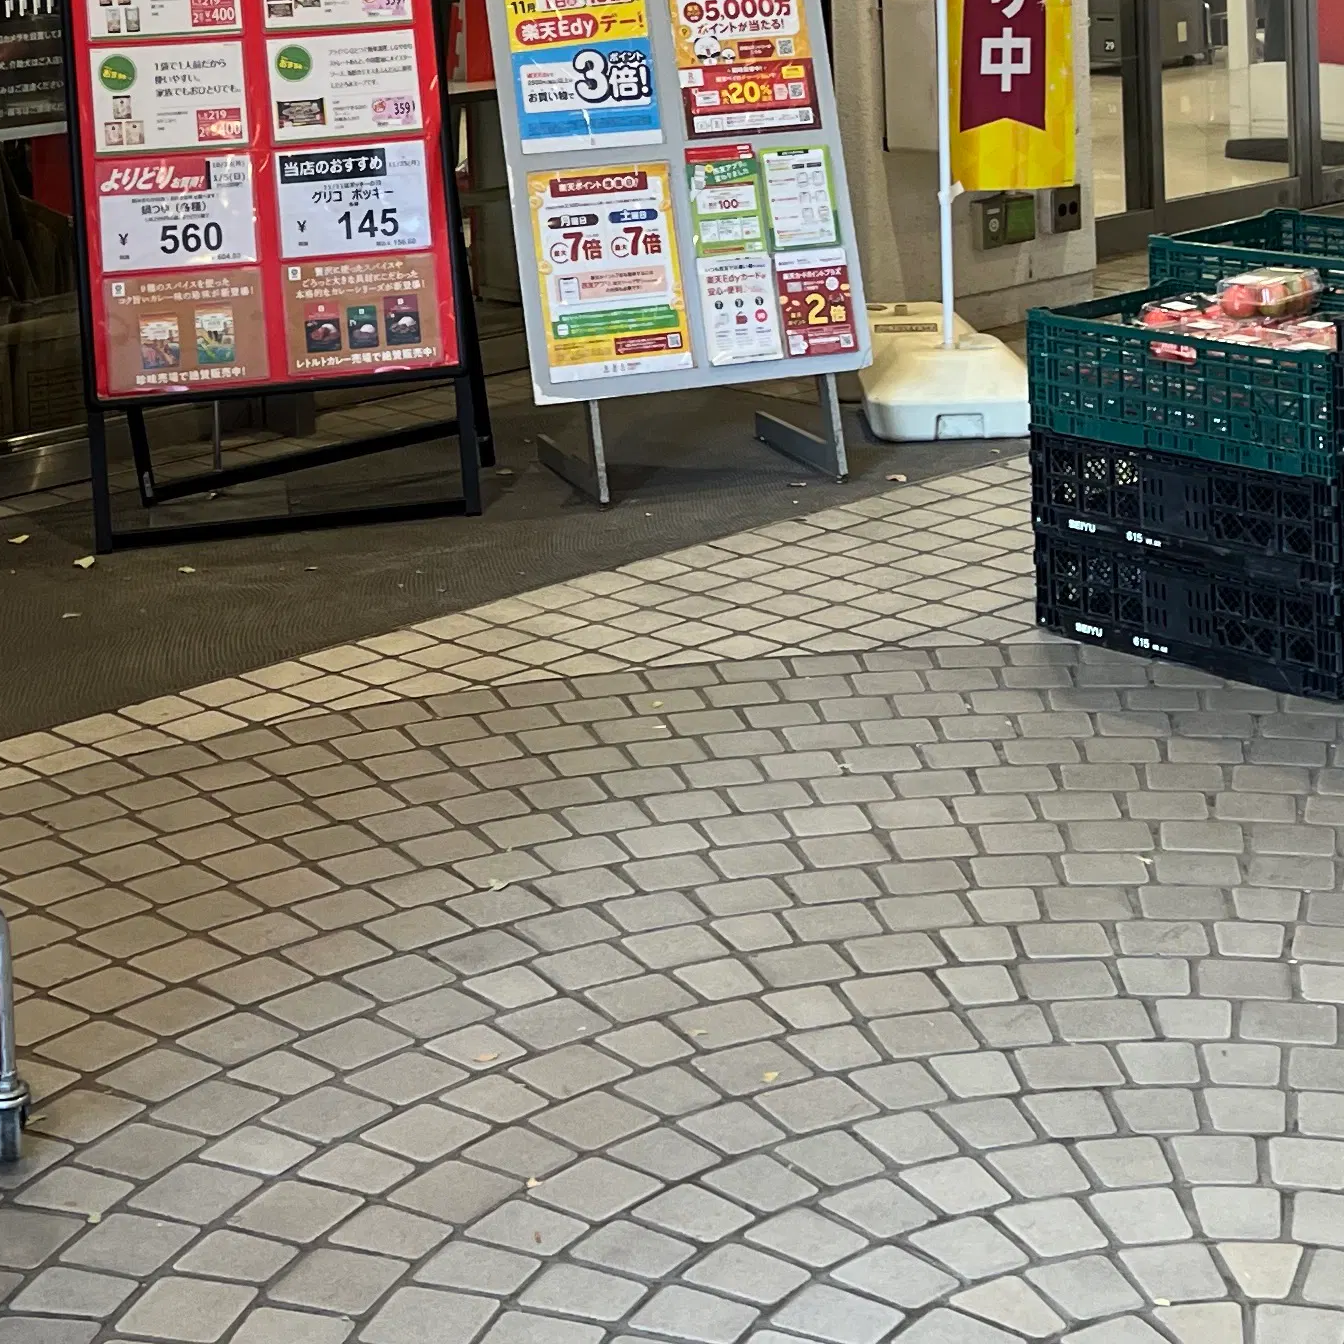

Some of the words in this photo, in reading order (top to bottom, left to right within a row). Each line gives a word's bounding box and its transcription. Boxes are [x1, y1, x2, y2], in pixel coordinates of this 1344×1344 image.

[521, 17, 594, 42] 楽天Edy
[284, 155, 384, 177] 当店のおすすめ
[311, 190, 343, 204] グリコ
[351, 187, 395, 201] ポッキー
[337, 207, 399, 240] 145
[159, 221, 223, 254] 560
[805, 292, 829, 325] 2
[1068, 519, 1097, 534] SEIYU
[1074, 622, 1104, 638] SEIYU
